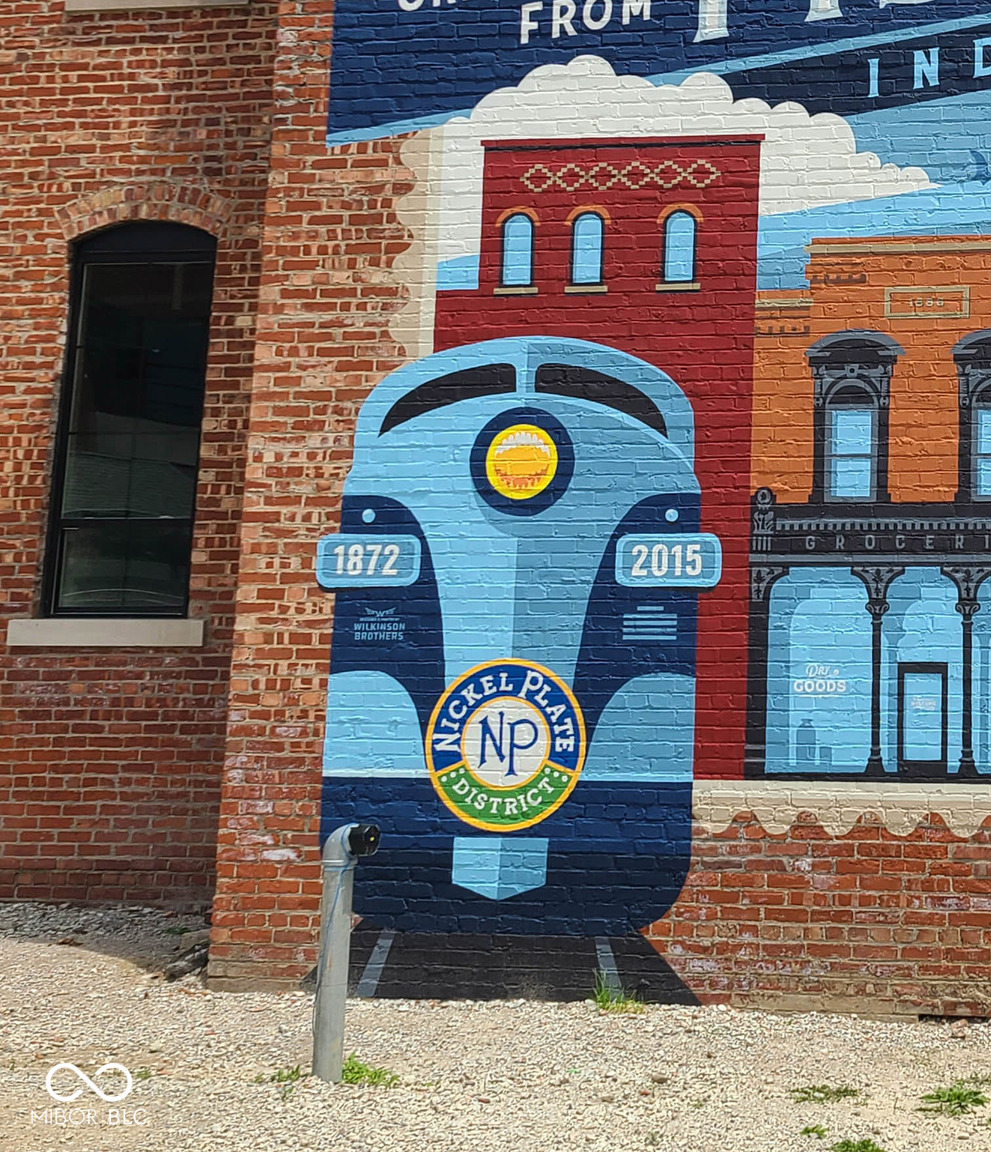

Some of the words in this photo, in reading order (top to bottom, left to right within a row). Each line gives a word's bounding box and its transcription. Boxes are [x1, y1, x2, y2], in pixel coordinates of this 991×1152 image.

[332, 544, 400, 577] 1872
[631, 542, 702, 577] 2015
[353, 622, 406, 631] WILKINSON
[354, 631, 404, 641] BROTHERS
[793, 680, 847, 693] GOODS
[432, 672, 514, 753] NICKEL
[517, 670, 575, 752] PLATE
[478, 711, 539, 777] NP
[452, 777, 555, 815] DISTRICT
